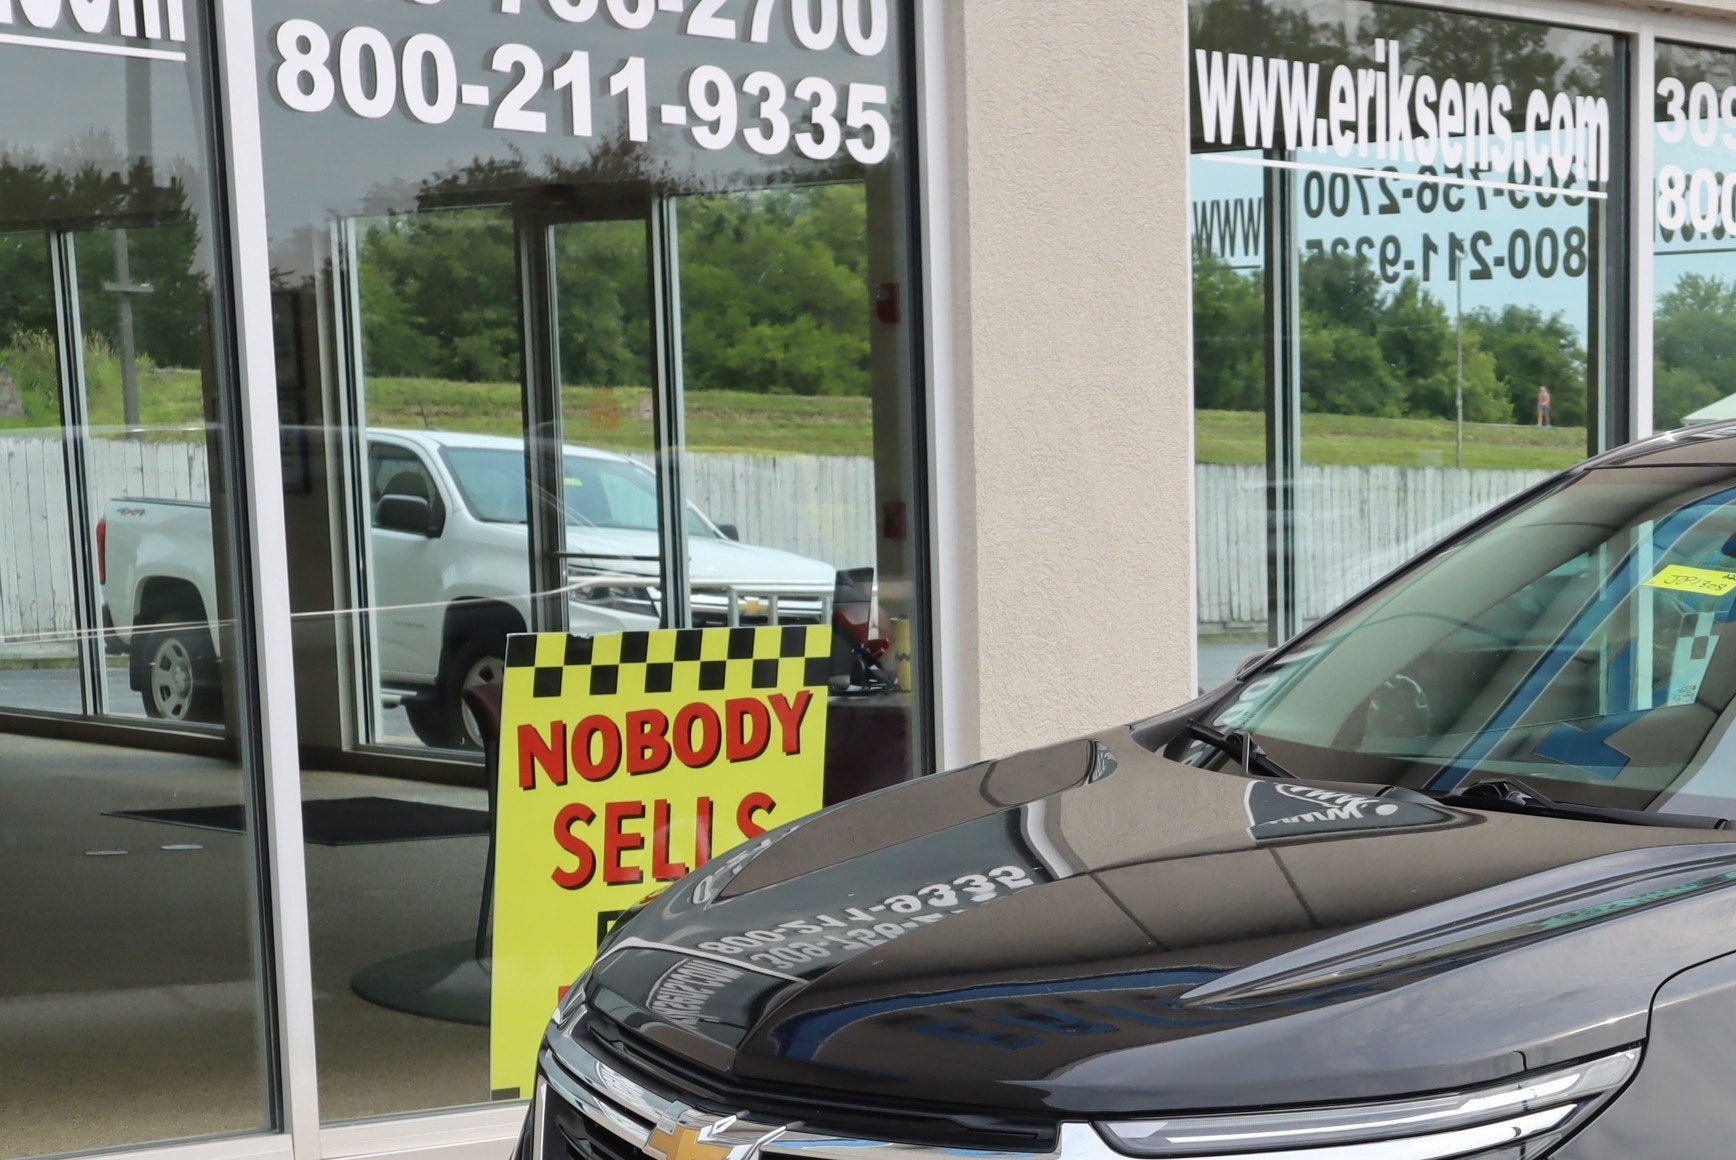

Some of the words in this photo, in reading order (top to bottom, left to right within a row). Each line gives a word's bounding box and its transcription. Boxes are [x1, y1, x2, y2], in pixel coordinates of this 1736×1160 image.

[276, 19, 891, 165] 800-211-9335
[1195, 39, 1609, 183] www.eriksens.com
[517, 690, 812, 789] NOBODY
